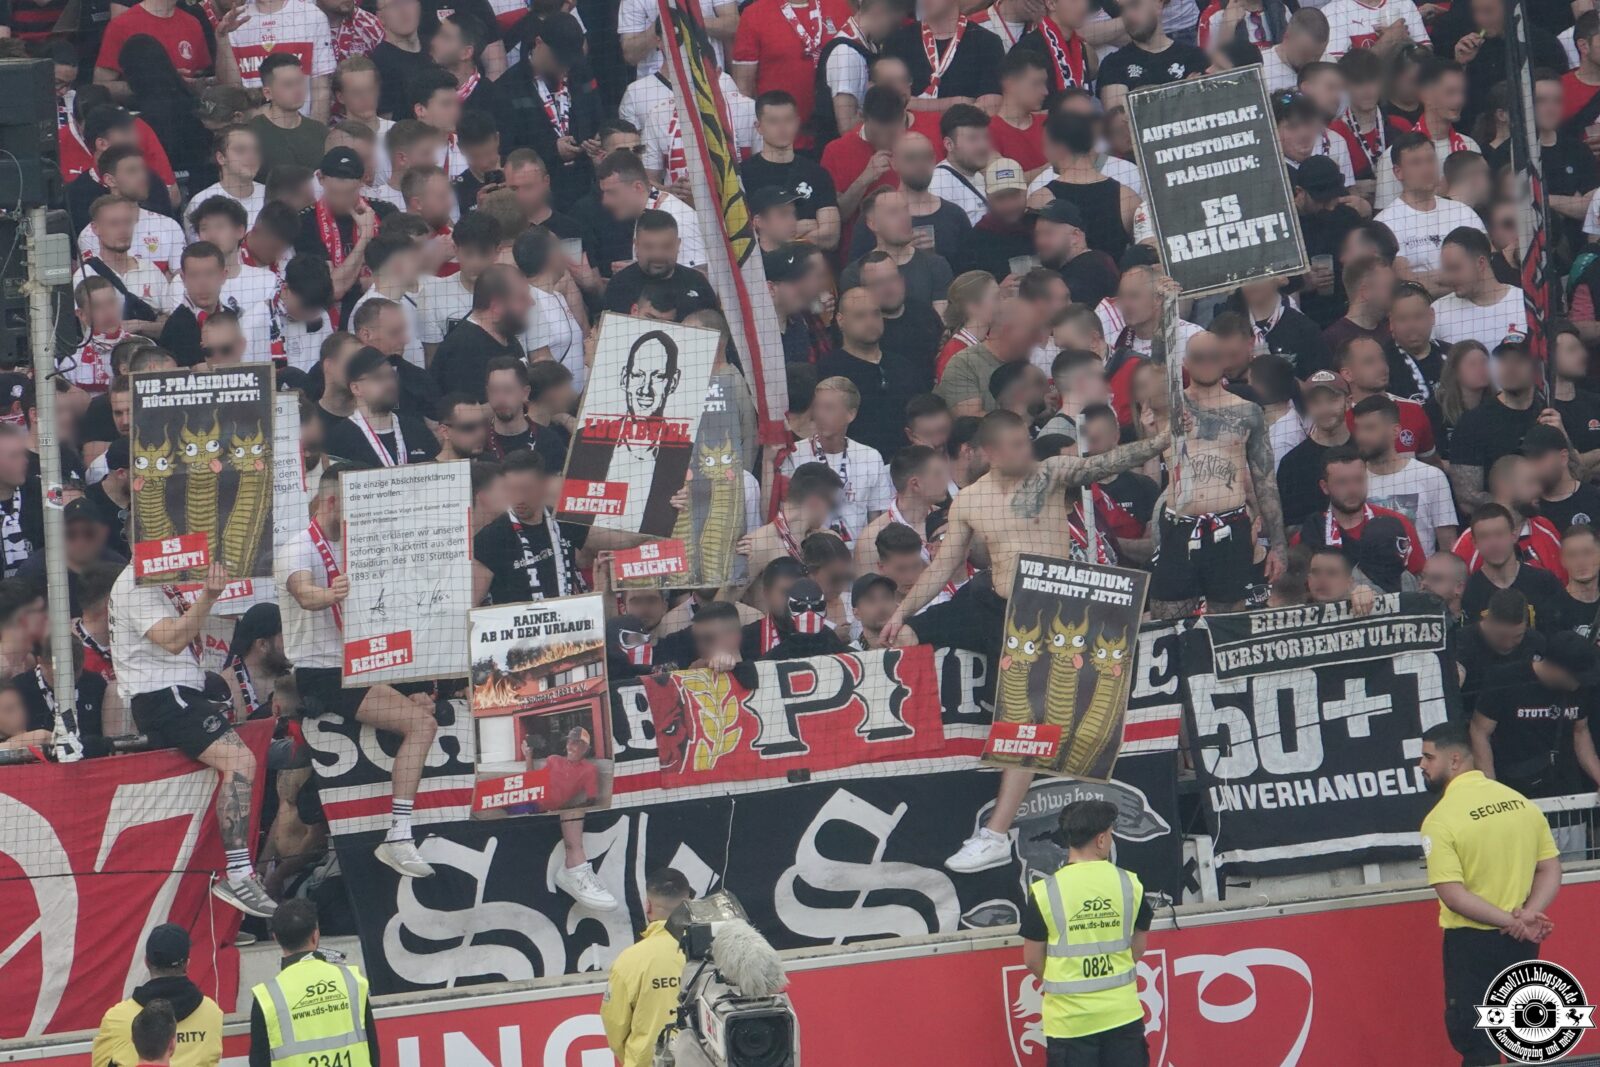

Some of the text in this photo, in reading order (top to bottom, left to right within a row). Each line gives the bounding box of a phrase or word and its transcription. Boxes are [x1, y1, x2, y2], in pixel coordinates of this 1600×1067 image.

[1142, 104, 1264, 144] AUFSICHTSRAT,
[1154, 130, 1260, 164] INVESTOREN,
[1165, 154, 1260, 187] PRÄSIDIUM:
[1201, 194, 1242, 228] ES
[1166, 212, 1290, 264] REICHT!
[142, 390, 260, 408] RÜCKTRITT JETZT!
[350, 473, 456, 490] Die einzige Absichtserklärung
[587, 482, 606, 497] ES
[565, 497, 621, 514] REICHT!
[350, 534, 379, 543] Hiermit
[418, 528, 429, 536] wir
[433, 525, 465, 535] unseren
[161, 538, 182, 554] ES
[350, 546, 391, 557] sofortigen
[446, 537, 465, 546] dem
[640, 544, 659, 560] ES
[142, 550, 204, 574] REICHT!
[392, 556, 407, 565] des
[429, 550, 465, 561] Stuttgart
[622, 556, 683, 578] REICHT!
[350, 572, 370, 582] 1893
[1022, 577, 1133, 606] RÜCKTRITT JETZT!
[513, 612, 561, 627] RAINER:
[1250, 606, 1320, 634] EHRE
[480, 619, 594, 643] AB IN DEN URLAUB!
[369, 636, 388, 653] ES
[1216, 628, 1366, 672] VERSTORBENEN
[1366, 622, 1442, 647] ULTRAS
[351, 648, 408, 674] REICHT!
[1016, 725, 1037, 739] ES
[993, 739, 1053, 755] REICHT!
[504, 775, 524, 790] ES
[481, 786, 544, 809] REICHT!
[1470, 800, 1526, 820] SECURITY
[1083, 899, 1112, 911] SDS
[1083, 954, 1114, 978] 0824
[306, 981, 337, 997] SDS
[292, 1002, 349, 1020] www.sds-bw.de
